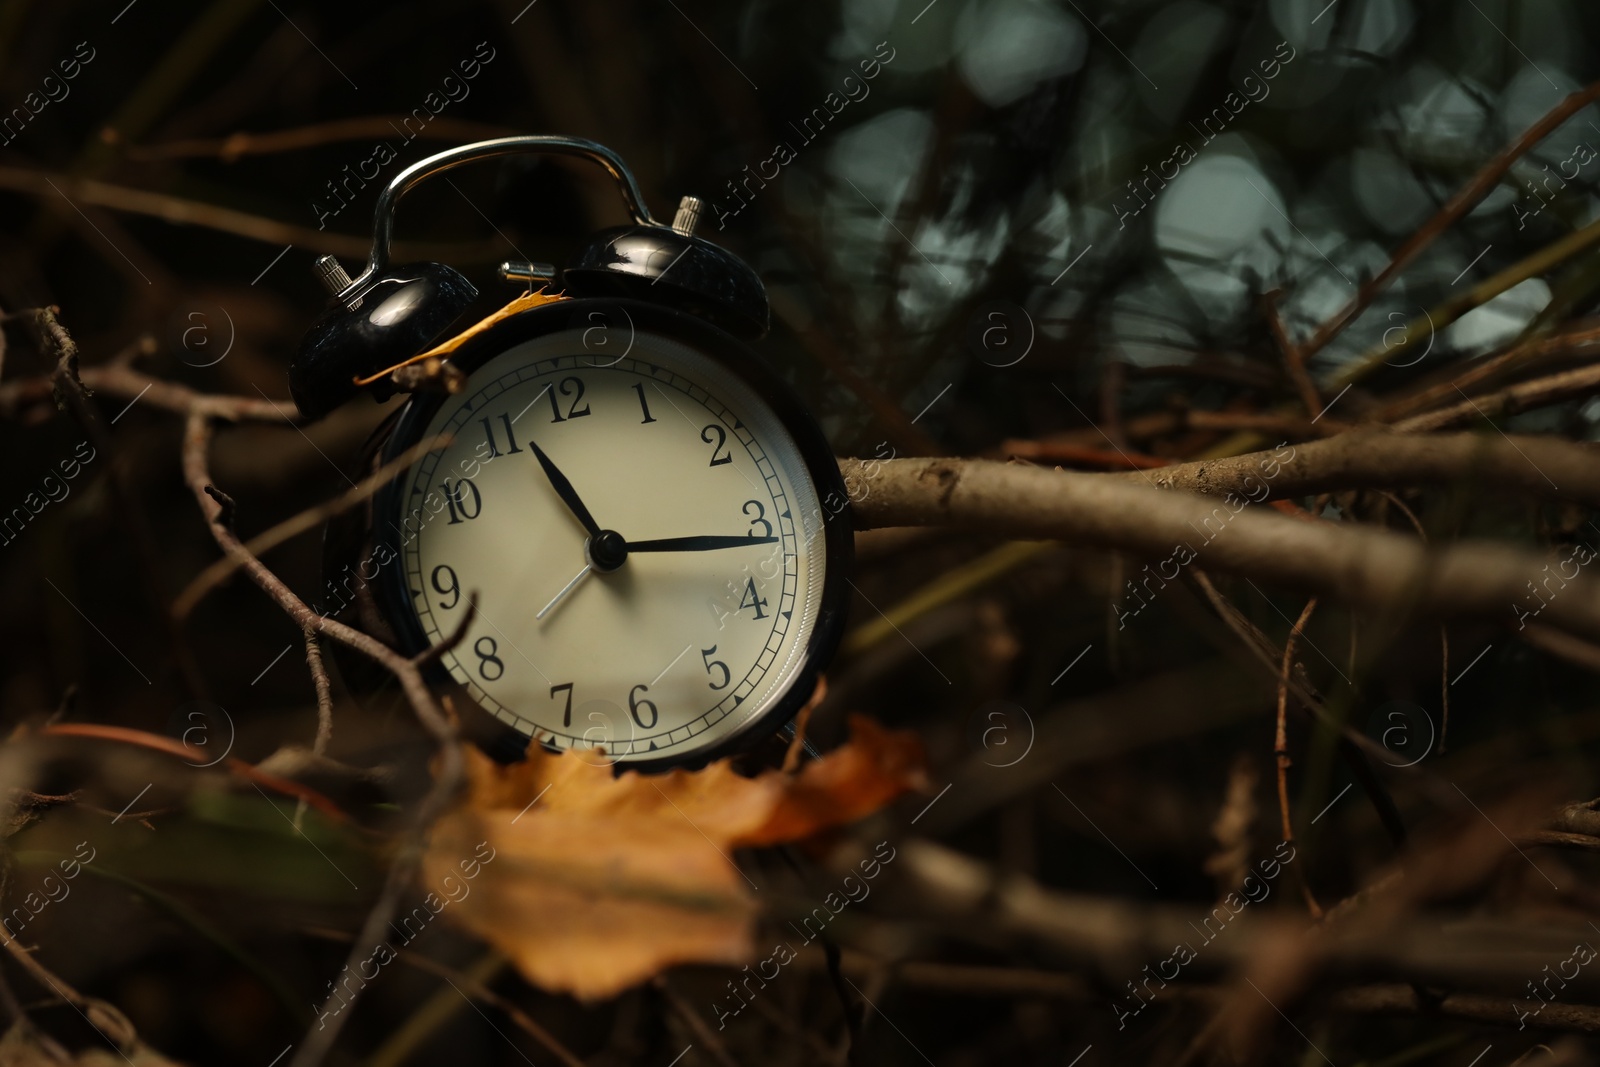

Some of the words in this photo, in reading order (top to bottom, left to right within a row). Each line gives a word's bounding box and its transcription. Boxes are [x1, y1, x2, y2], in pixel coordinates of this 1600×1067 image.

[542, 376, 591, 423] 12
[631, 382, 657, 424] 1
[478, 412, 523, 459] 11
[701, 424, 733, 467] 2
[438, 478, 482, 525] 10
[742, 500, 773, 538] 3
[431, 564, 460, 610] 9
[739, 576, 770, 621] 4
[474, 636, 504, 681] 8
[701, 644, 731, 690] 5
[550, 682, 574, 728] 7
[628, 684, 658, 729] 6
